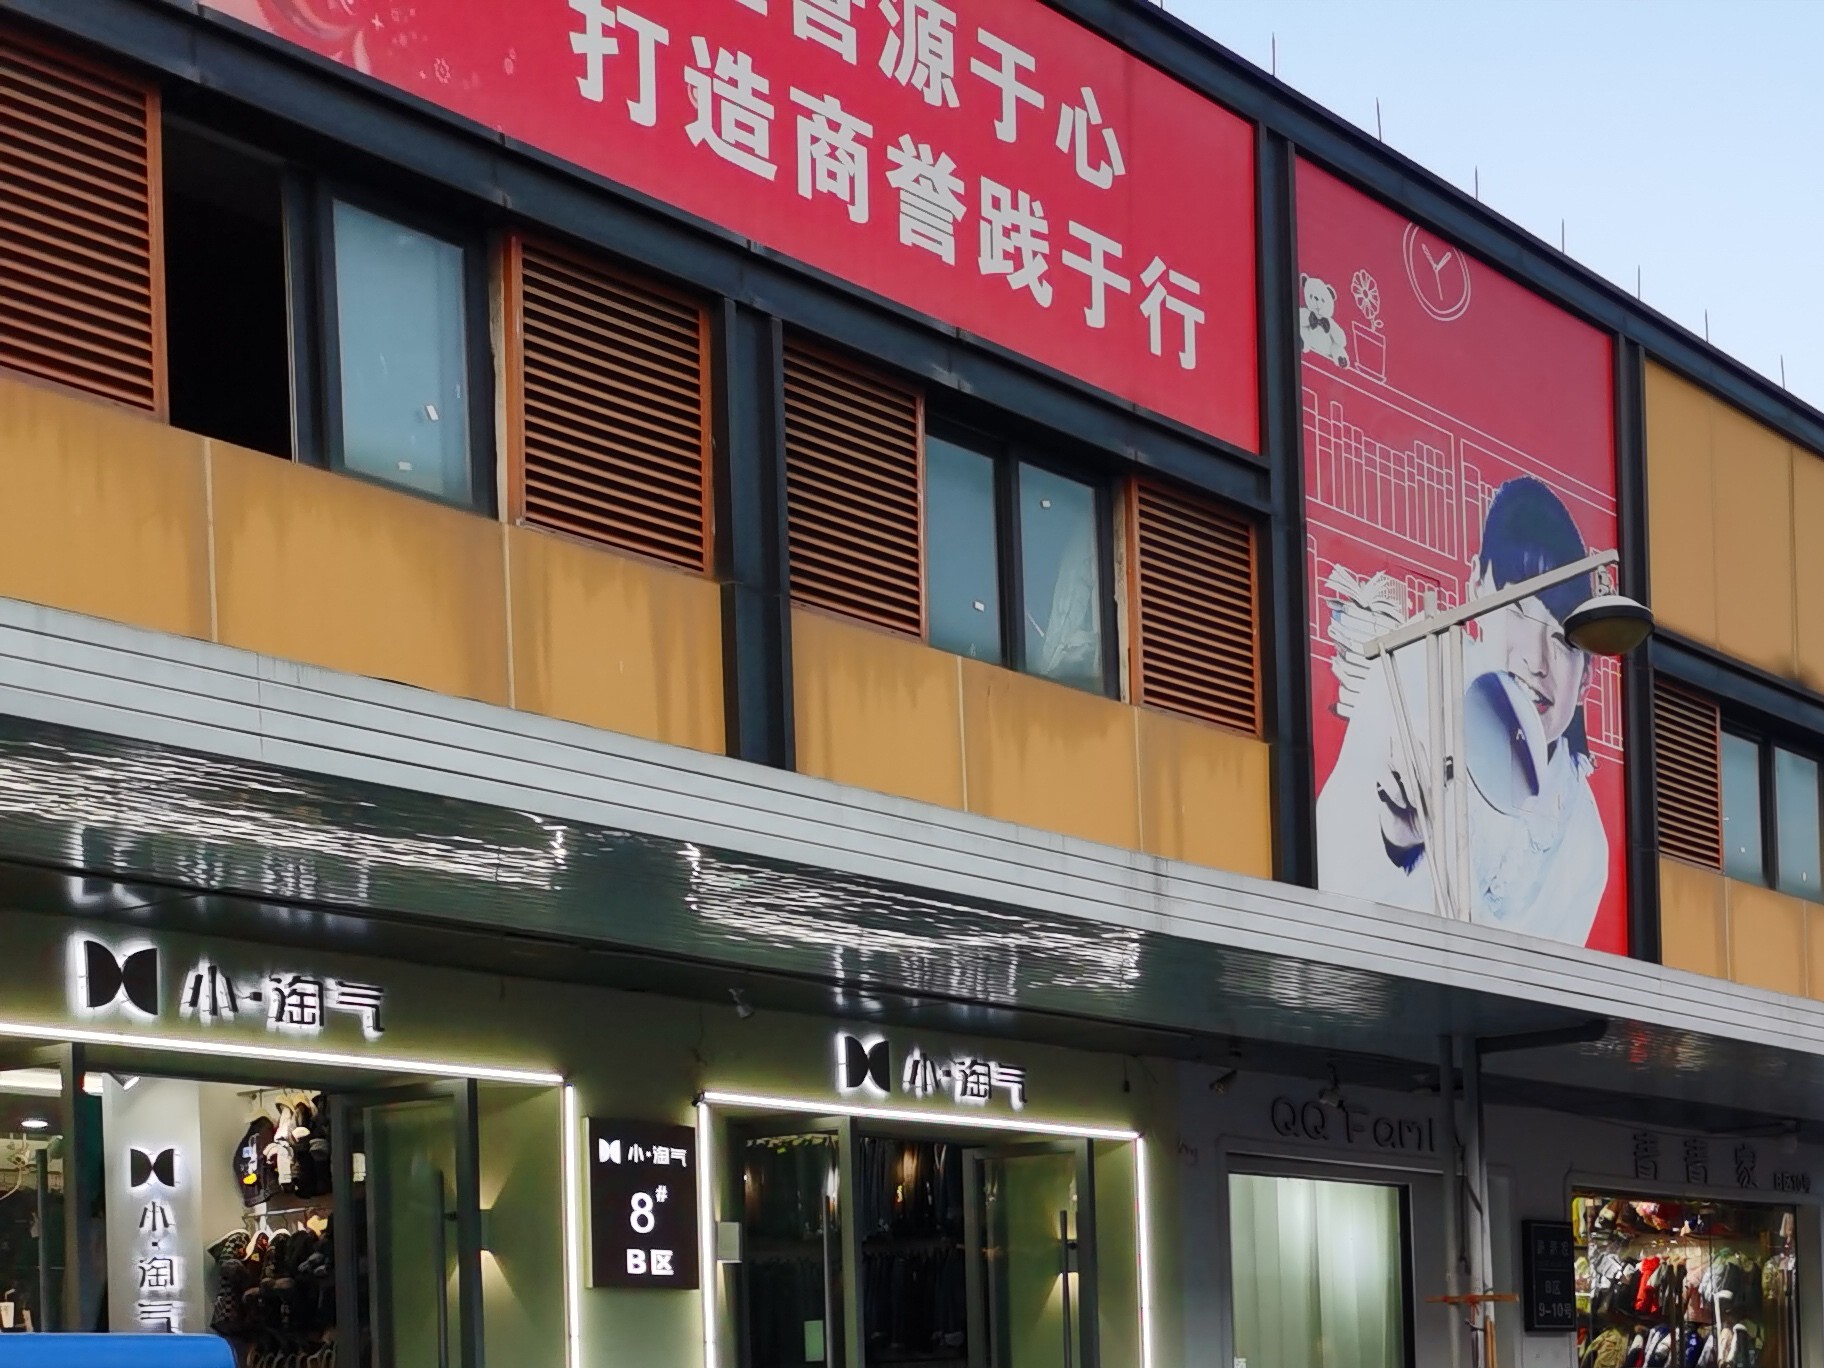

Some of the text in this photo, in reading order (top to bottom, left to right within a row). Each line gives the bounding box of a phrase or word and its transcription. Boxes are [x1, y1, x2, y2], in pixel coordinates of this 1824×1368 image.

[569, 0, 1205, 370] 打造商誉践于行
[626, 1248, 675, 1276] B区
